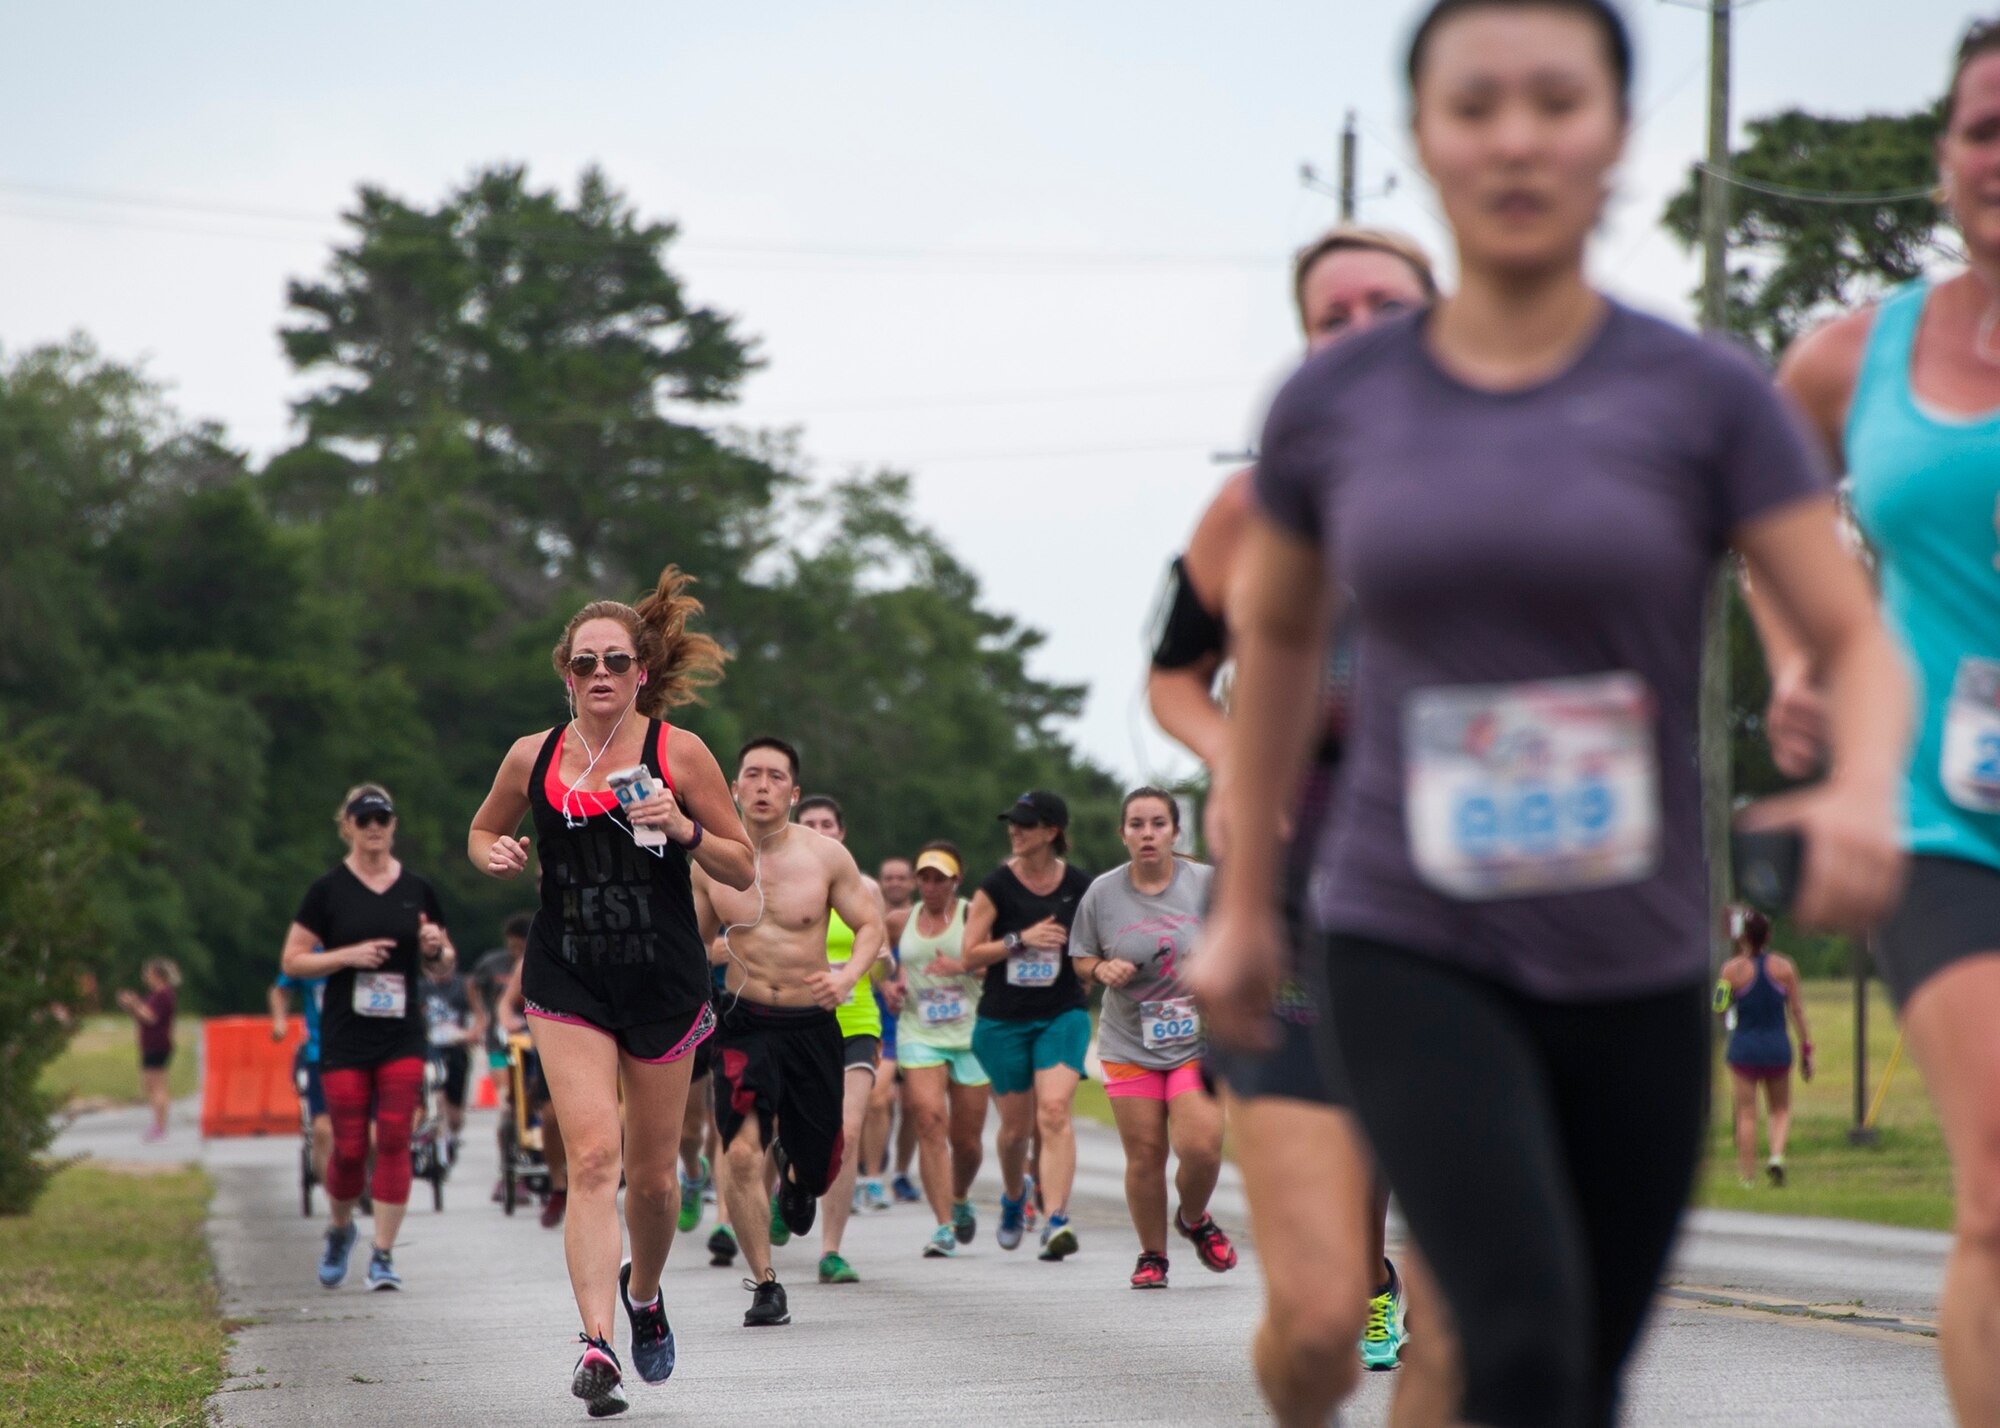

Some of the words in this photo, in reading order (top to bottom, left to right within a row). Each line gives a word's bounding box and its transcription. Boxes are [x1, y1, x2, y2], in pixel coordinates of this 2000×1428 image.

[1017, 962, 1053, 977] 228
[370, 993, 394, 1008] 23
[1152, 1019, 1195, 1038] 602
